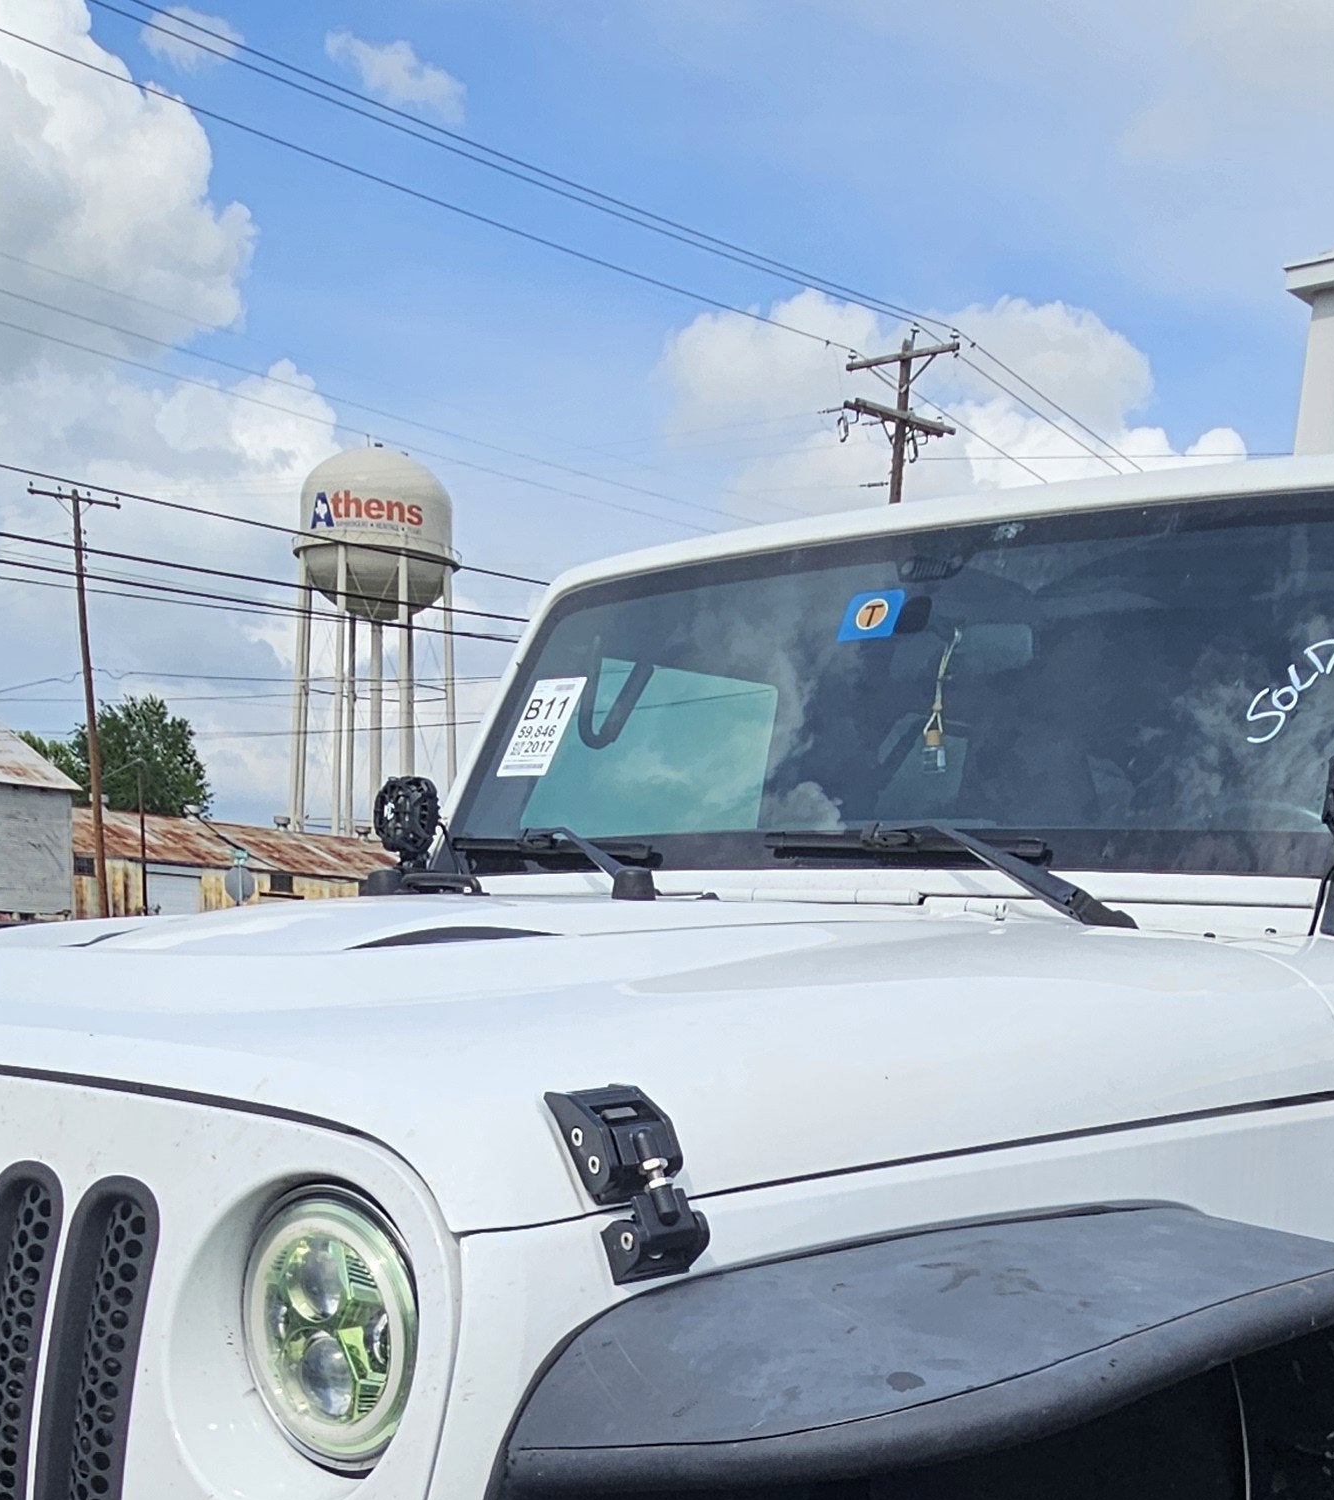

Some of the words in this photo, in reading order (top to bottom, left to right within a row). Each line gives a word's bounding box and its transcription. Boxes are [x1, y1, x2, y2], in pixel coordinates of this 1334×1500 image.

[311, 489, 424, 529] Athens
[865, 603, 884, 628] T
[524, 696, 571, 721] B11
[524, 740, 555, 753] 2017
